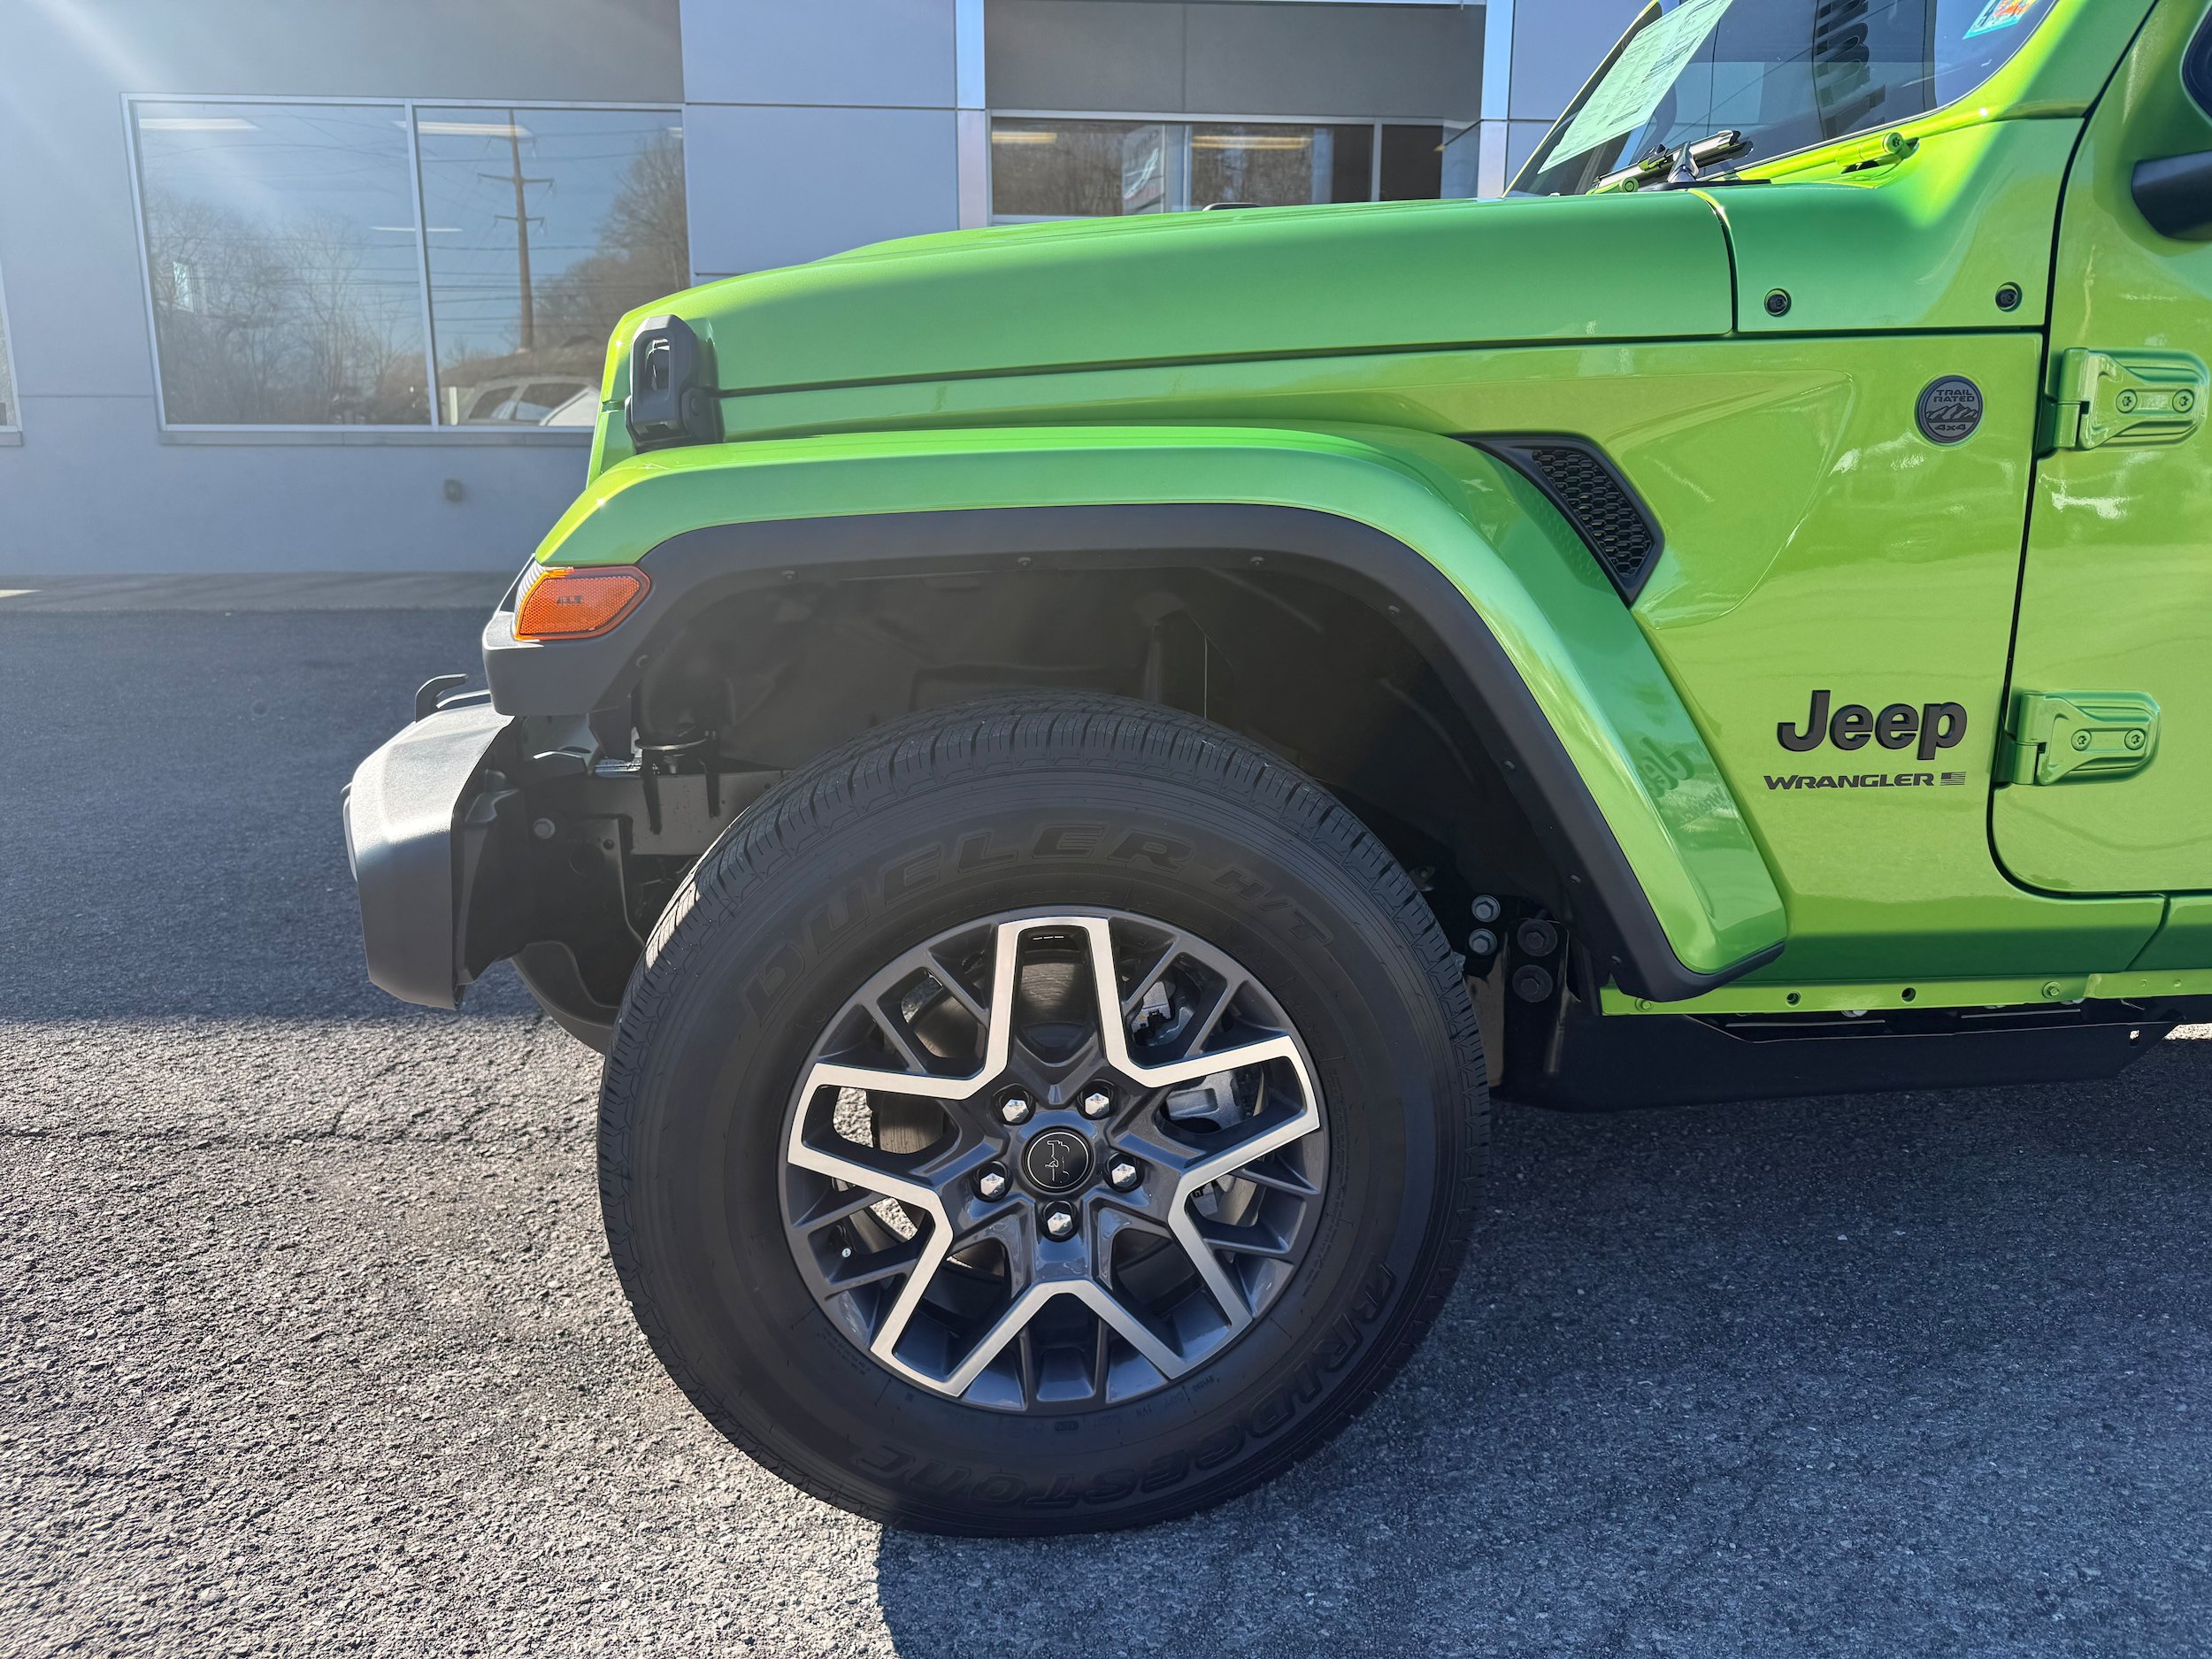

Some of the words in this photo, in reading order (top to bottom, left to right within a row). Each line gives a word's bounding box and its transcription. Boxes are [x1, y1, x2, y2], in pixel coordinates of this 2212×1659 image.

[1763, 772, 1935, 790] WRANGLER
[1777, 689, 1967, 760] Jeep
[741, 822, 1195, 1028] DUELER
[1210, 866, 1336, 949] H/T
[855, 1263, 1398, 1508] BRIDGESTONE
